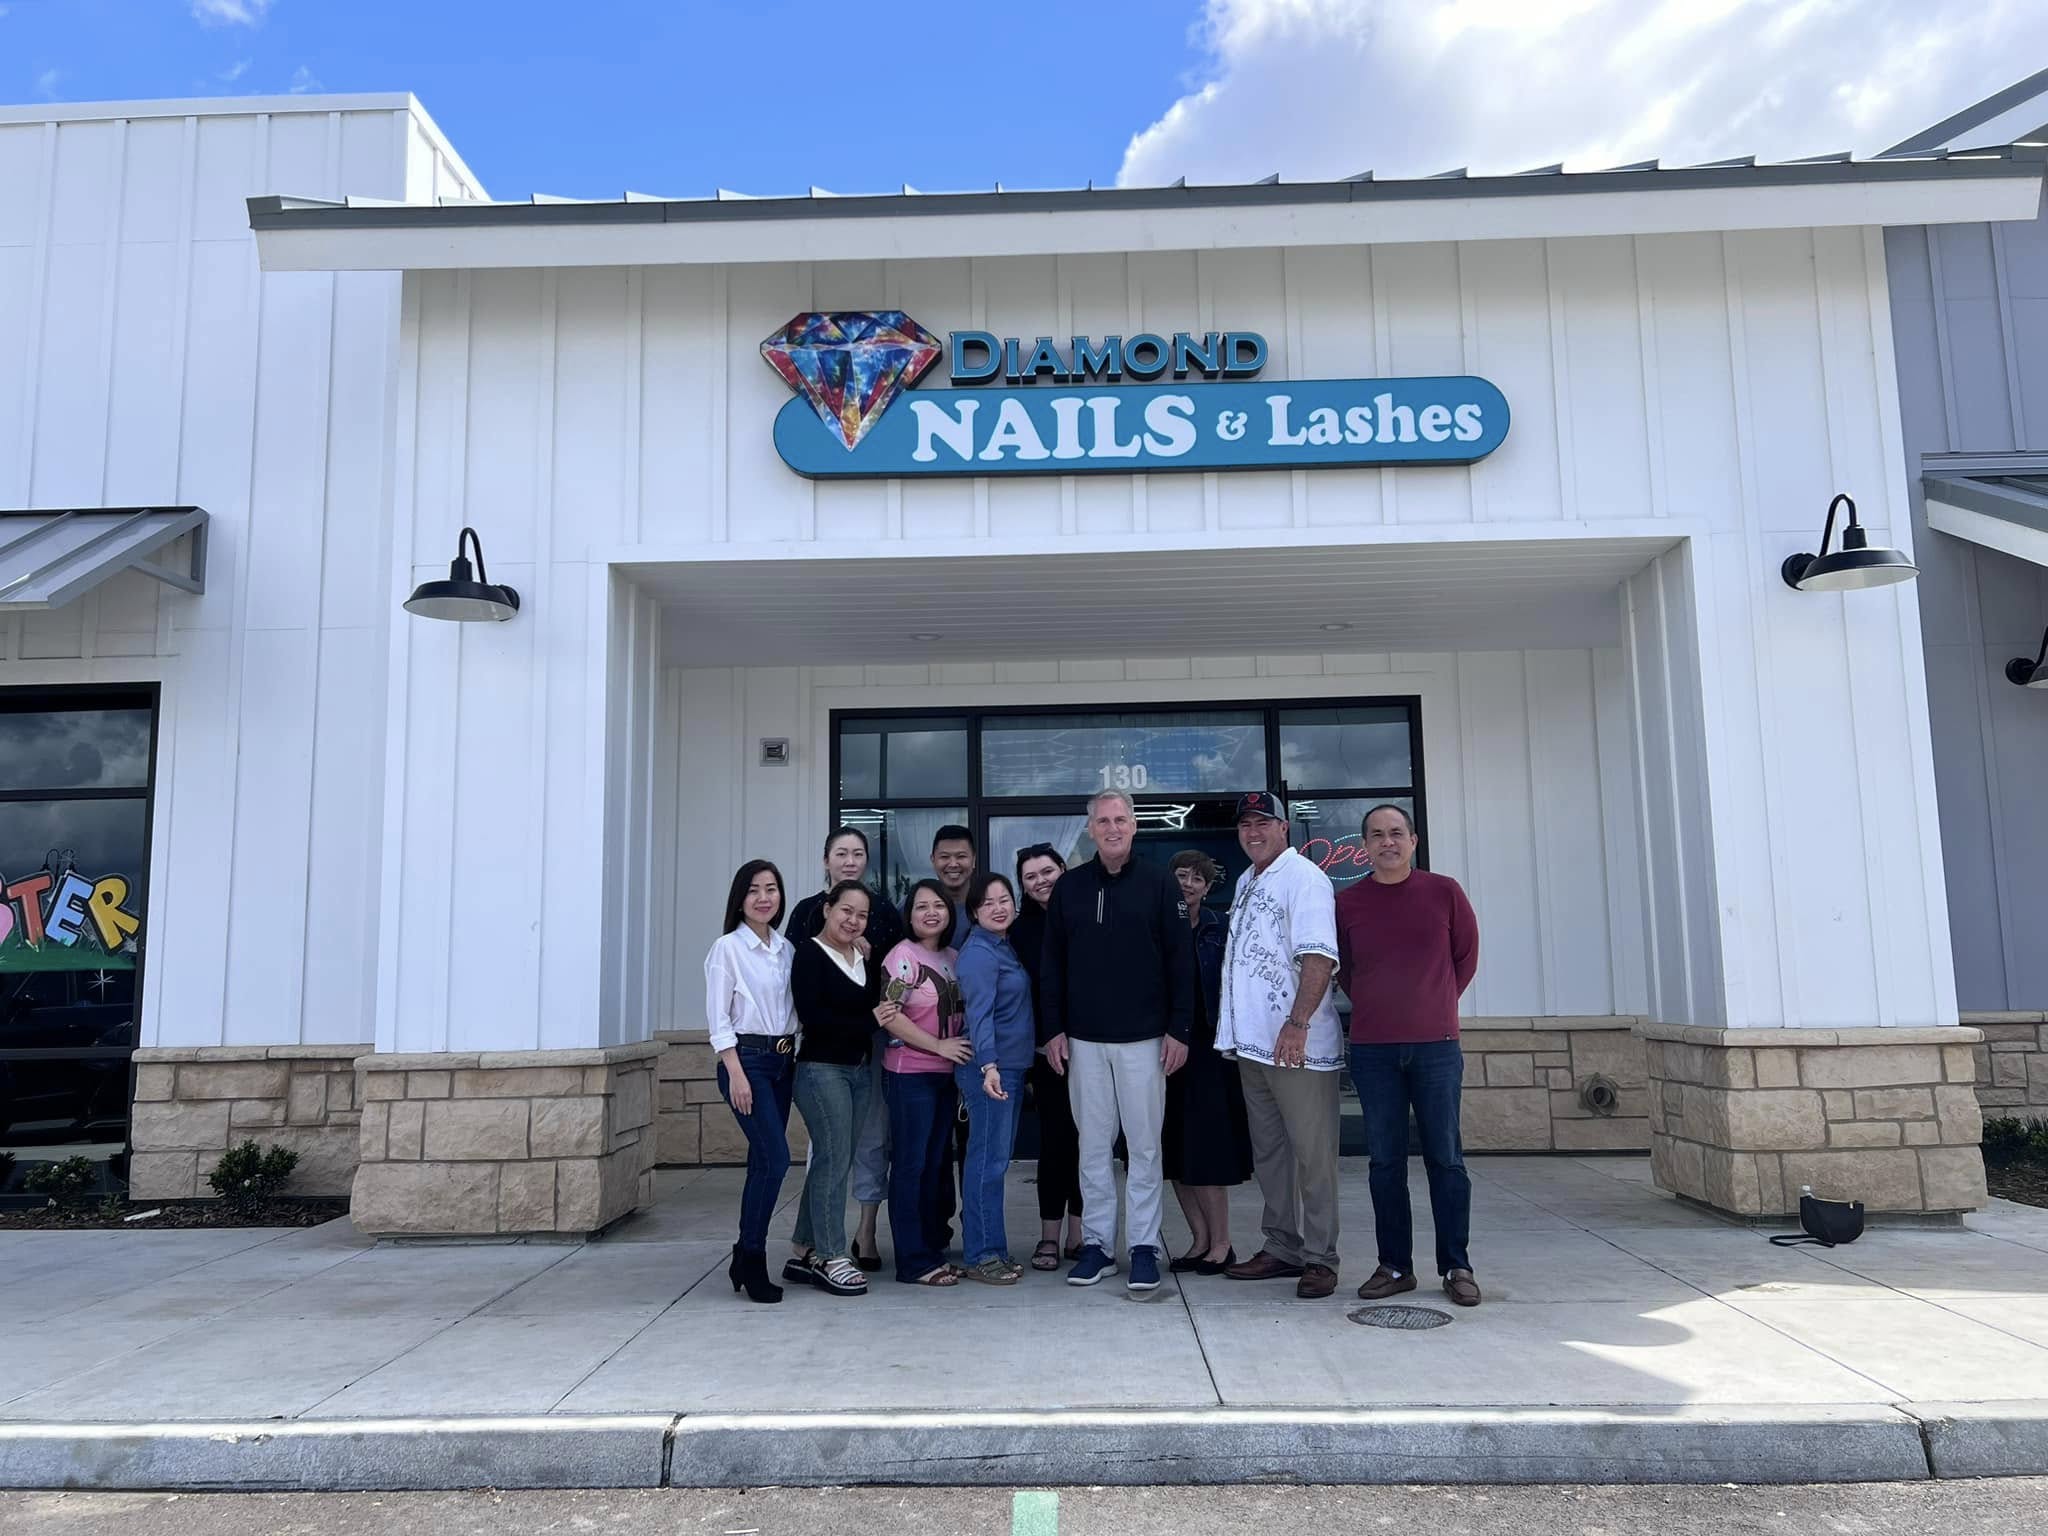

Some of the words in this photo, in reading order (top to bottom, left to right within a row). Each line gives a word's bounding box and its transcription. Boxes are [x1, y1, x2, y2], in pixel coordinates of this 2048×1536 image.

[910, 395, 1196, 461] NAILS
[1217, 411, 1247, 440] &
[1267, 394, 1482, 446] Lashes
[1099, 764, 1147, 789] 130
[1299, 838, 1374, 872] Ope
